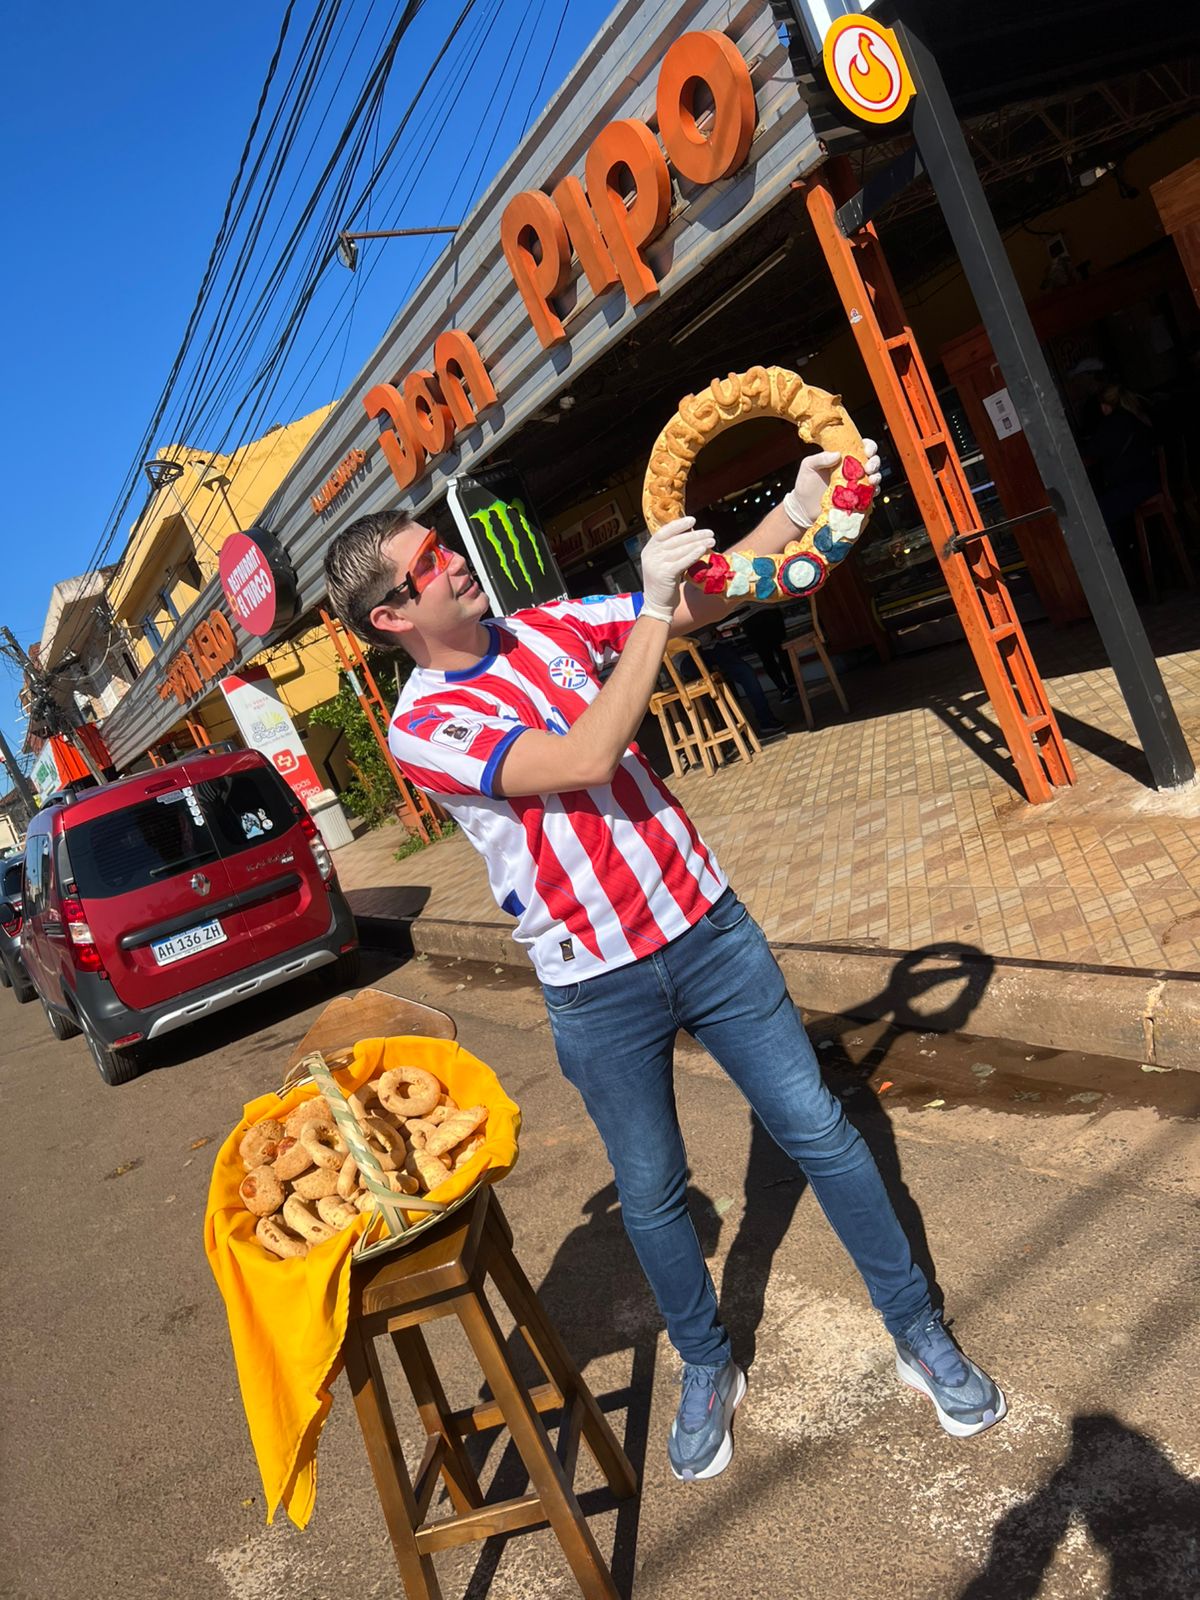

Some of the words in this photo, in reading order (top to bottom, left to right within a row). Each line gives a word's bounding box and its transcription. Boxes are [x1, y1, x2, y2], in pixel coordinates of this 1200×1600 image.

[242, 568, 272, 611] TURCO
[158, 943, 175, 960] AH
[176, 932, 201, 951] 136
[204, 925, 221, 943] ZH
